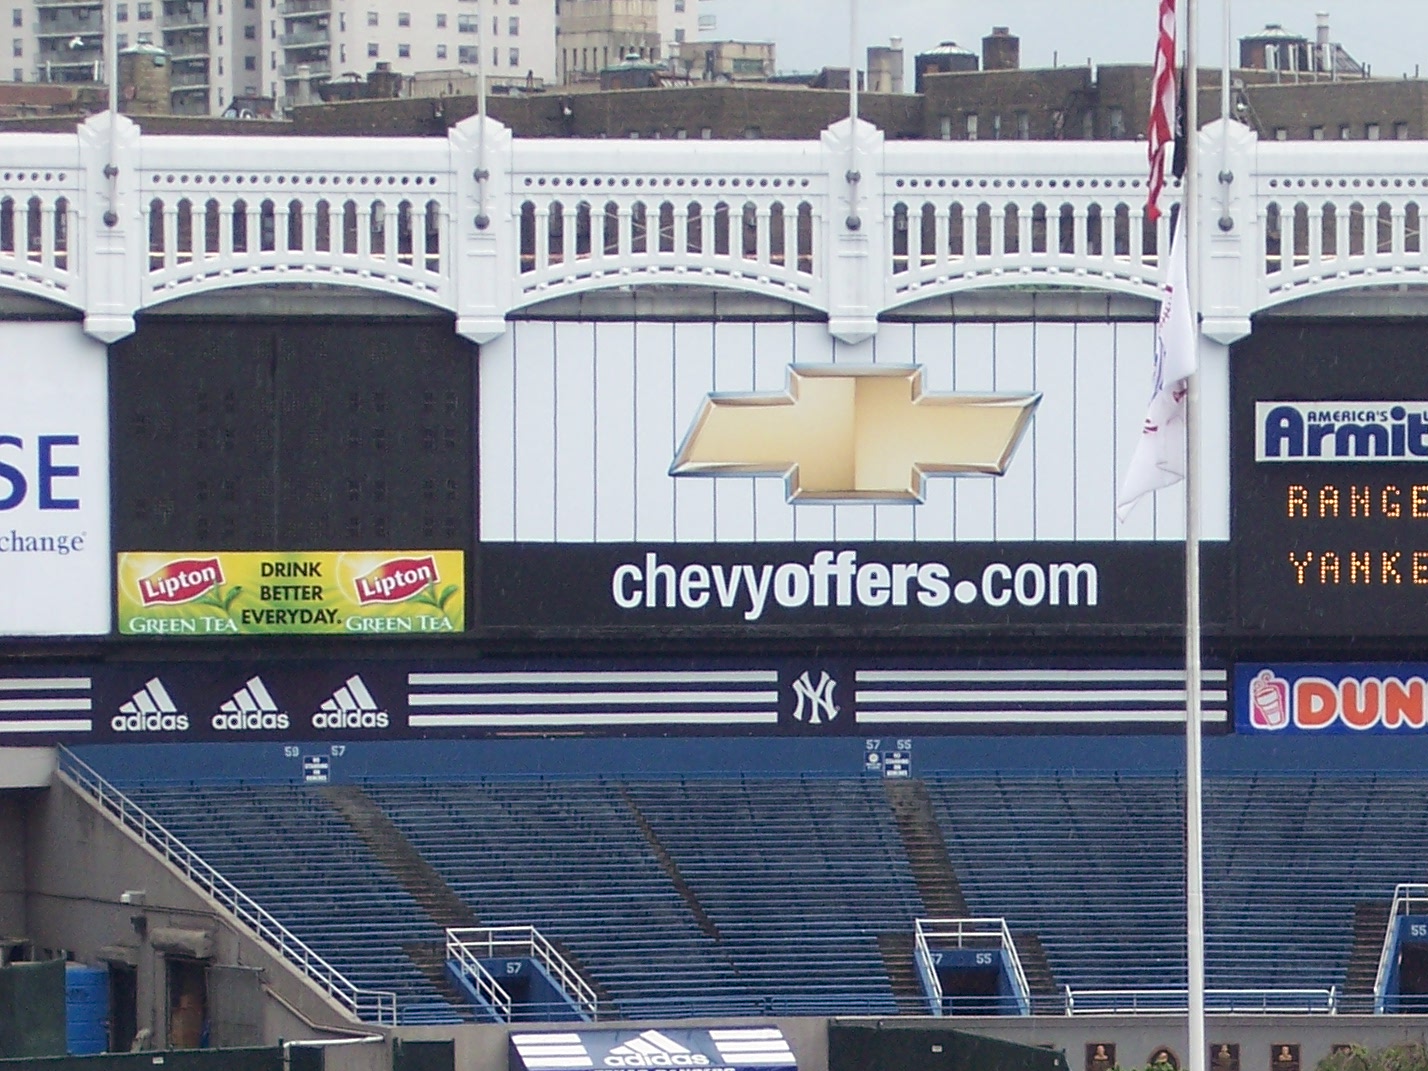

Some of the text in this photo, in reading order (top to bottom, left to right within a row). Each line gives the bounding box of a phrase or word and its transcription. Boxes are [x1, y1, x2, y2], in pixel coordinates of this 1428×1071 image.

[1307, 411, 1388, 422] AMERICA'S
[261, 562, 322, 577] DRINK
[145, 567, 216, 598] Lipton
[362, 566, 430, 597] Lipton
[612, 550, 1098, 620] chevyoffers.com
[261, 586, 323, 601] BETTER
[242, 609, 342, 624] EVERYDAY.
[111, 710, 189, 732] adidas
[211, 710, 290, 731] adidas
[311, 709, 390, 730] adidas
[331, 745, 346, 757] 57
[866, 739, 880, 750] 57
[1411, 925, 1427, 937] 55
[976, 953, 992, 965] 55
[506, 962, 522, 974] 57
[604, 1053, 710, 1066] adidas
